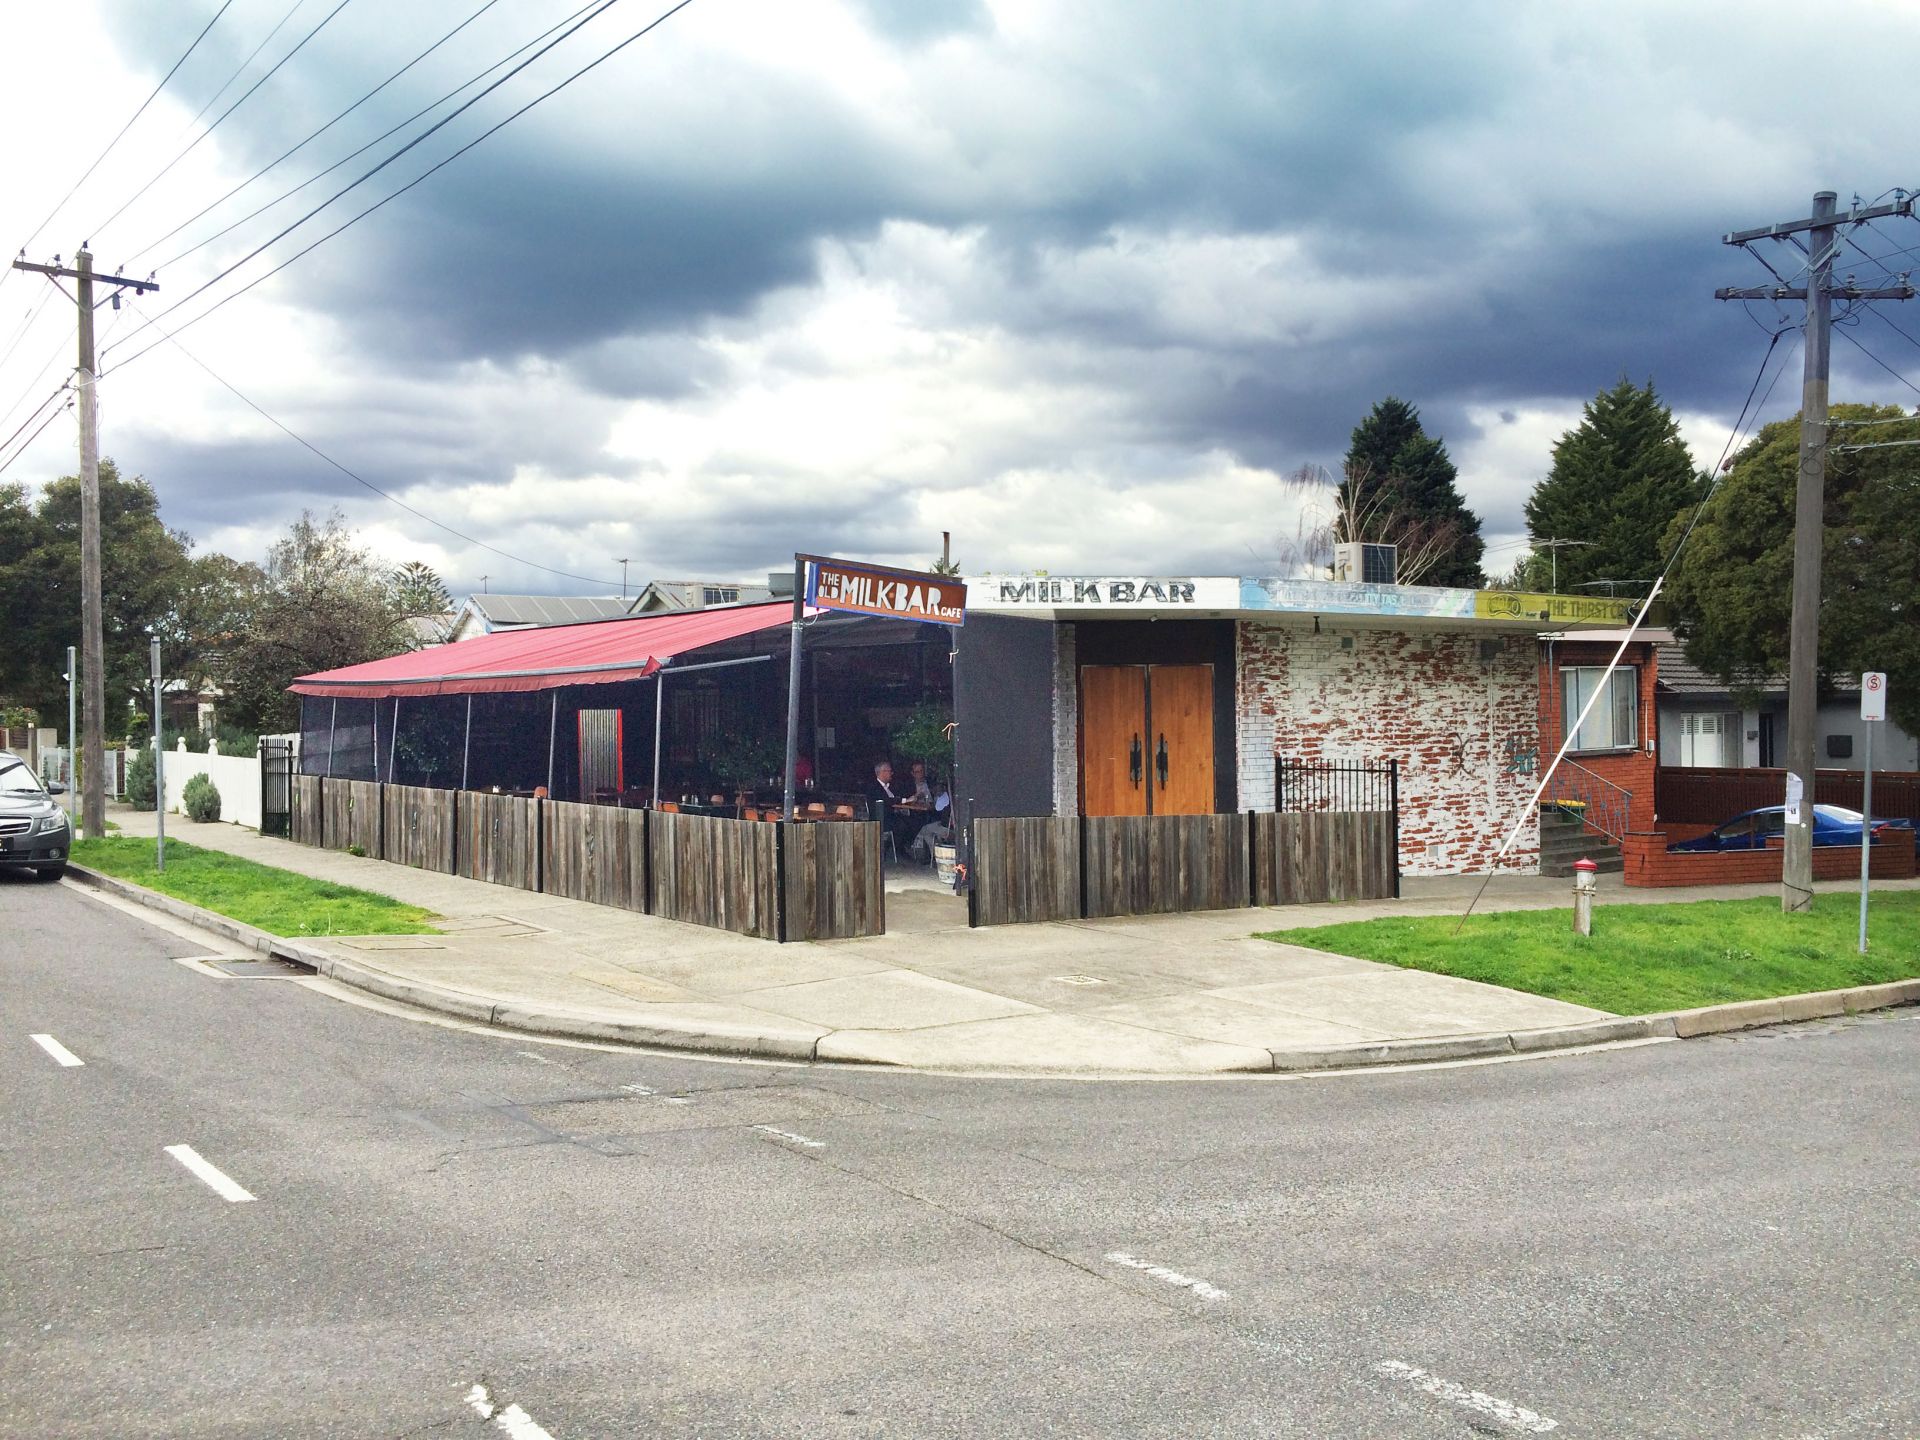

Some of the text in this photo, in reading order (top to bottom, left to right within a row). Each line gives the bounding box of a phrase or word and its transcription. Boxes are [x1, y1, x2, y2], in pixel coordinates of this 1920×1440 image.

[821, 571, 840, 586] THE
[818, 585, 839, 599] OLD
[1000, 581, 1195, 603] MILK BAR
[940, 606, 962, 619] CAFE
[1546, 599, 1568, 617] THE
